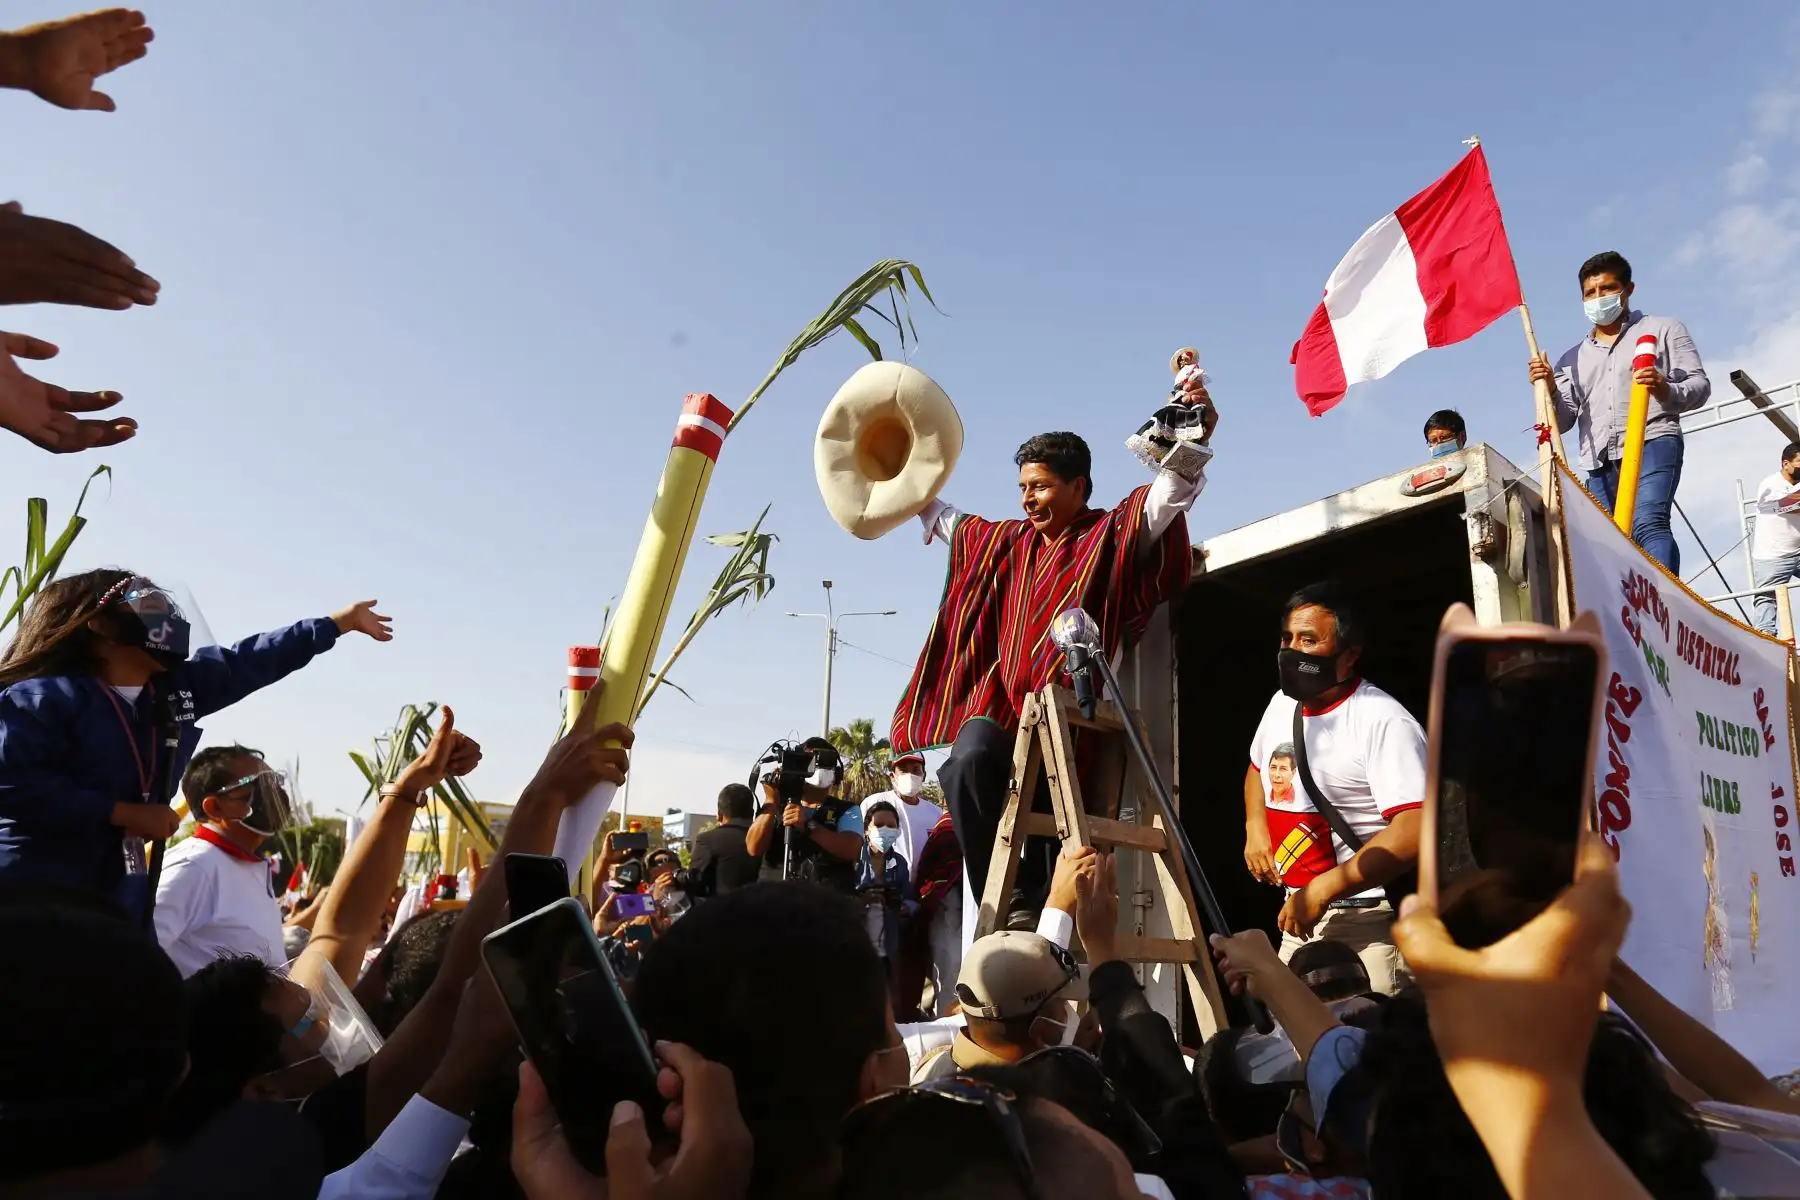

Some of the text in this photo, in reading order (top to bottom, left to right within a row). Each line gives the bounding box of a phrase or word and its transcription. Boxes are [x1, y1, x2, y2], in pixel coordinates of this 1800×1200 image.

[1676, 620, 1742, 686] DISTRITAL
[1696, 711, 1760, 758] POLITICO
[1700, 770, 1741, 815] LIBRE
